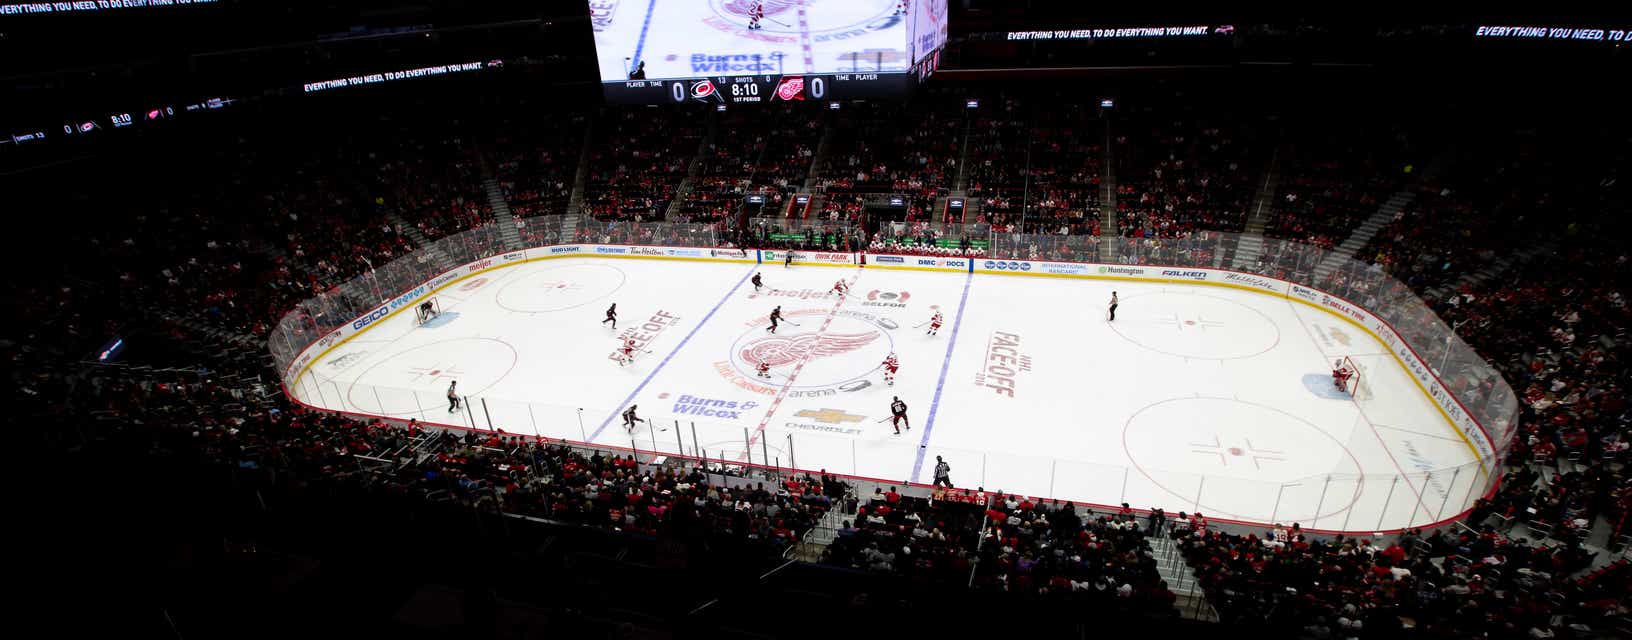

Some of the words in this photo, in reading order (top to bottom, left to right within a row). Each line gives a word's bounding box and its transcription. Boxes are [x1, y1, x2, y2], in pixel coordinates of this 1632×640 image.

[53, 2, 72, 11] YOU
[73, 1, 98, 10] NEED,
[100, 0, 110, 8] TO
[111, 0, 122, 8] DO
[1007, 30, 1053, 40] EVERYTHING
[1054, 29, 1069, 39] YOU
[1070, 29, 1092, 38] NEED,
[1093, 29, 1103, 37] TO
[1104, 29, 1115, 37] DO
[1116, 27, 1164, 37] EVERYTHING
[1165, 27, 1182, 36] YOU
[1183, 26, 1208, 35] WANT.
[1476, 26, 1547, 37] EVERYTHING
[1549, 27, 1572, 38] YOU
[1571, 28, 1605, 41] NEED,
[1608, 30, 1625, 41] TO
[691, 53, 763, 62] Burns
[691, 63, 774, 72] Wilcox
[304, 78, 347, 92] EVERYTHING
[348, 76, 363, 85] YOU
[364, 75, 384, 83] NEED,
[395, 71, 405, 79] DO
[405, 66, 446, 78] EVERYTHING
[447, 63, 461, 72] YOU
[462, 62, 482, 70] WANT.
[673, 82, 685, 101] 0
[732, 83, 758, 96] 8:10
[811, 78, 824, 98] 0
[166, 107, 173, 116] 0
[111, 113, 131, 124] 8:10
[64, 125, 72, 134] 0
[469, 260, 492, 272] meijer
[1108, 266, 1144, 276] Huntington
[1162, 270, 1208, 278] FALKEN
[1329, 301, 1350, 314] BELLE
[1351, 311, 1365, 321] TIRE
[353, 306, 388, 330] GEICO
[730, 378, 777, 395] Caesars
[788, 388, 836, 398] arena
[677, 394, 737, 409] Burns
[740, 400, 759, 410] &
[672, 404, 742, 420] Wilcox
[785, 422, 864, 435] CHEVROLET
